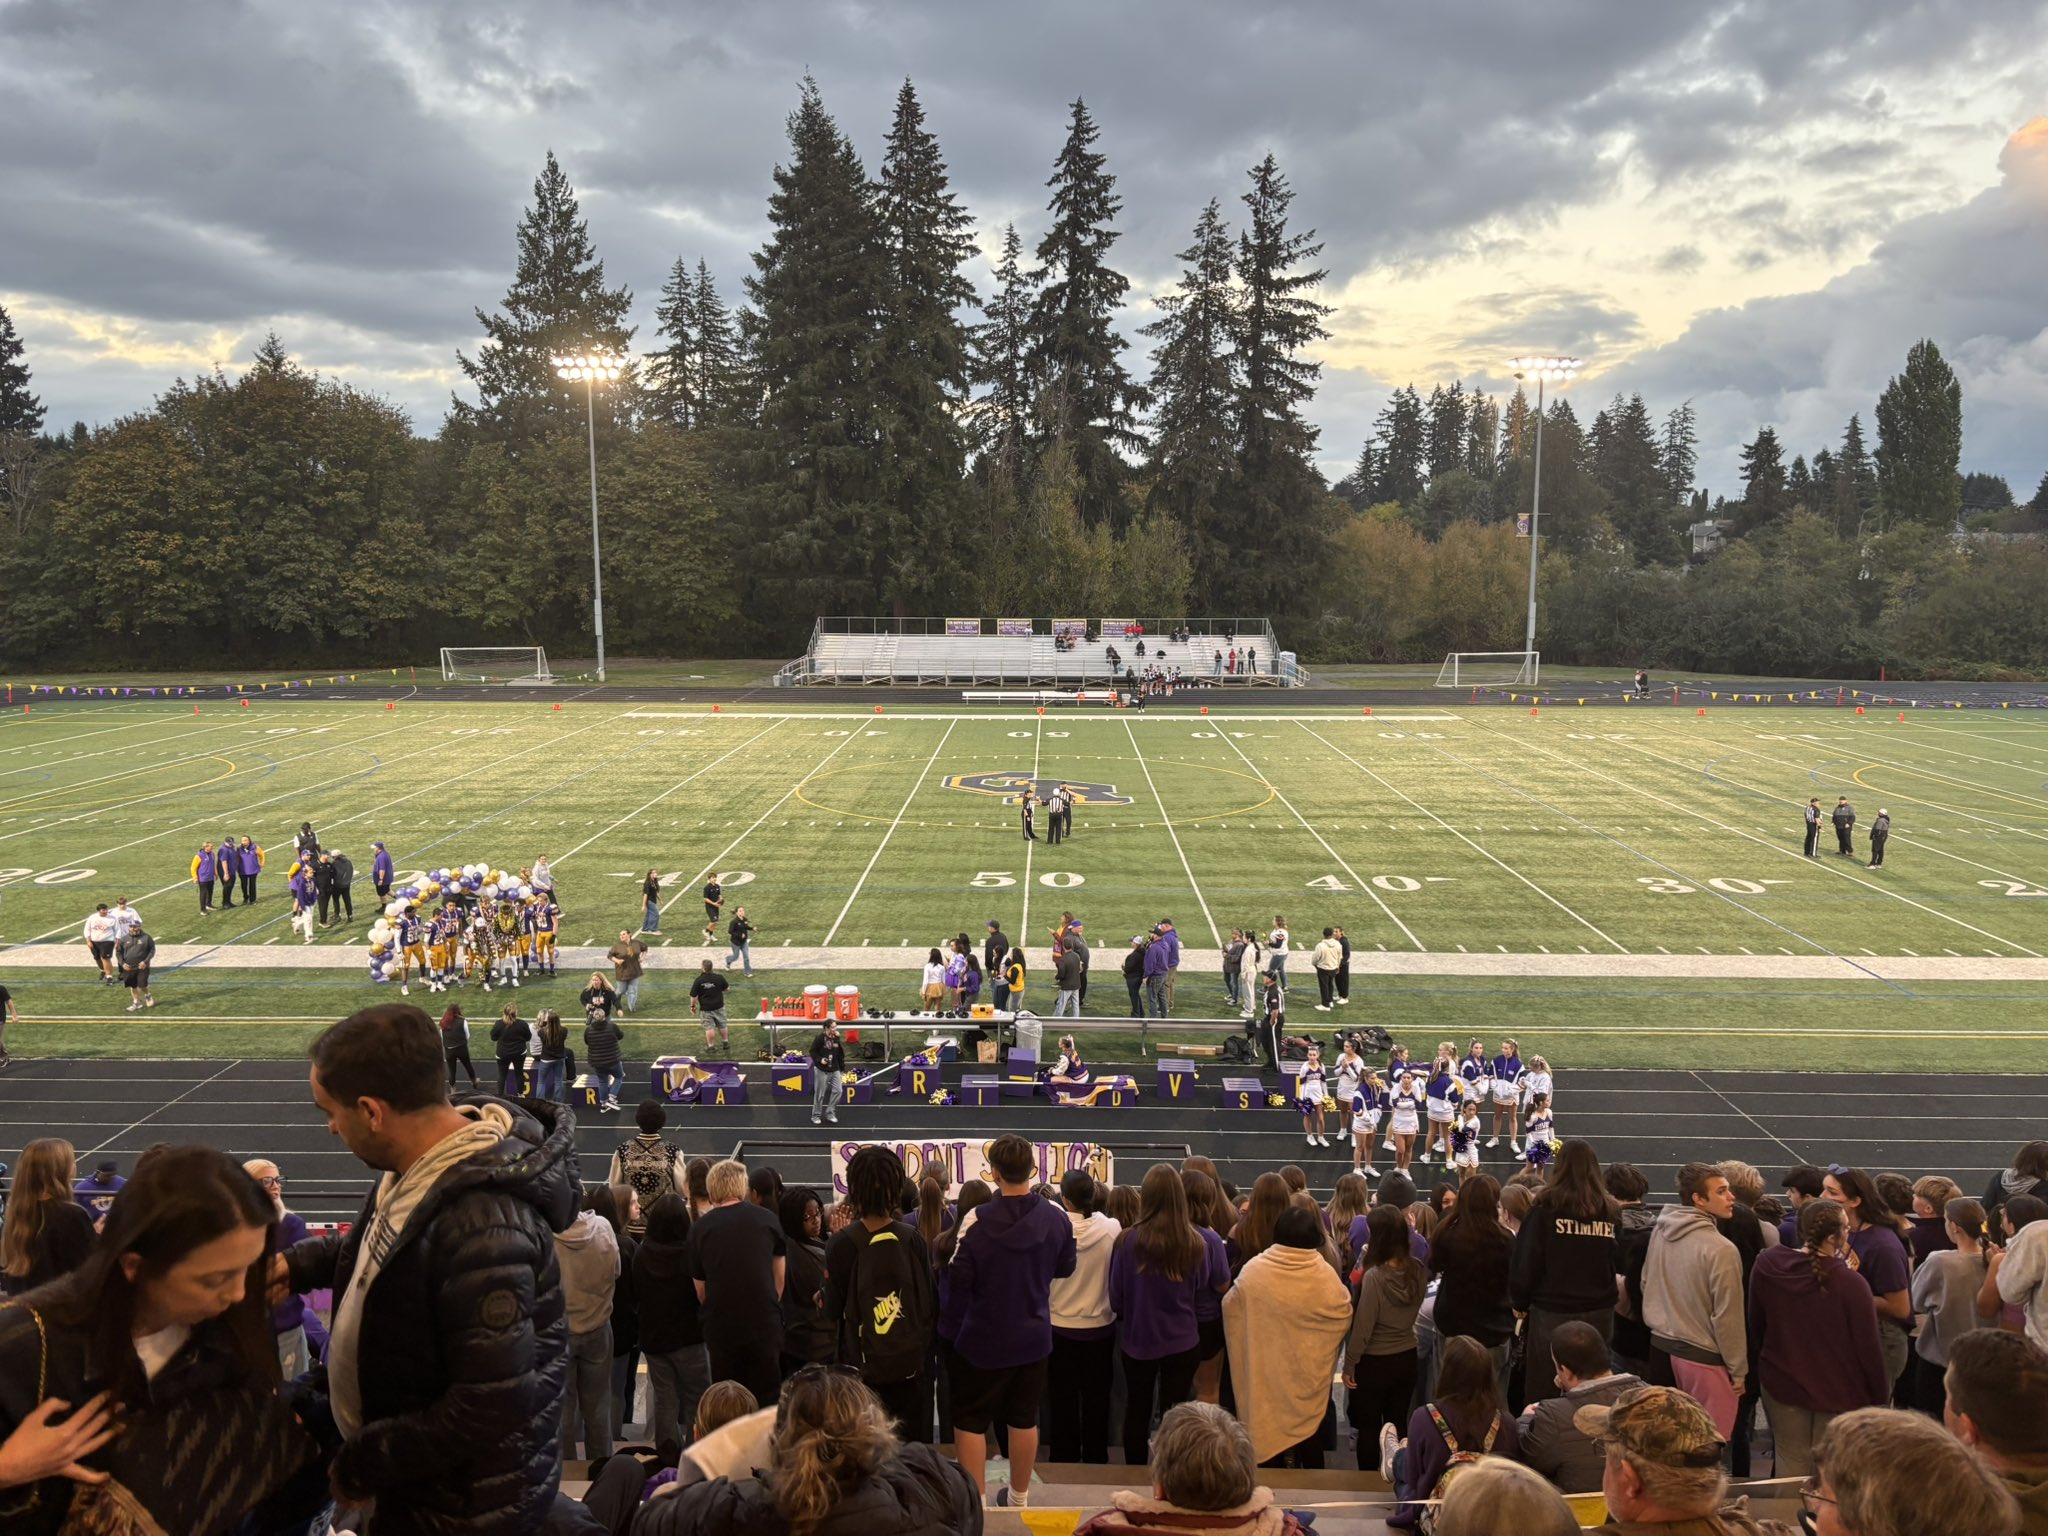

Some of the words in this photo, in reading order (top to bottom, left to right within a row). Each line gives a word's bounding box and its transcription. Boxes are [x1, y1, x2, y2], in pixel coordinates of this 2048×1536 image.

[970, 871, 1086, 889] 50
[1304, 874, 1422, 892] 40
[1636, 876, 1767, 895] 30
[812, 998, 820, 1007] G
[841, 998, 849, 1007] G
[913, 1070, 926, 1095] R
[1170, 1073, 1183, 1098] V
[586, 1088, 596, 1105] R
[716, 1088, 726, 1105] A
[847, 1088, 856, 1104] P
[1112, 1090, 1122, 1107] D
[1239, 1092, 1249, 1109] S
